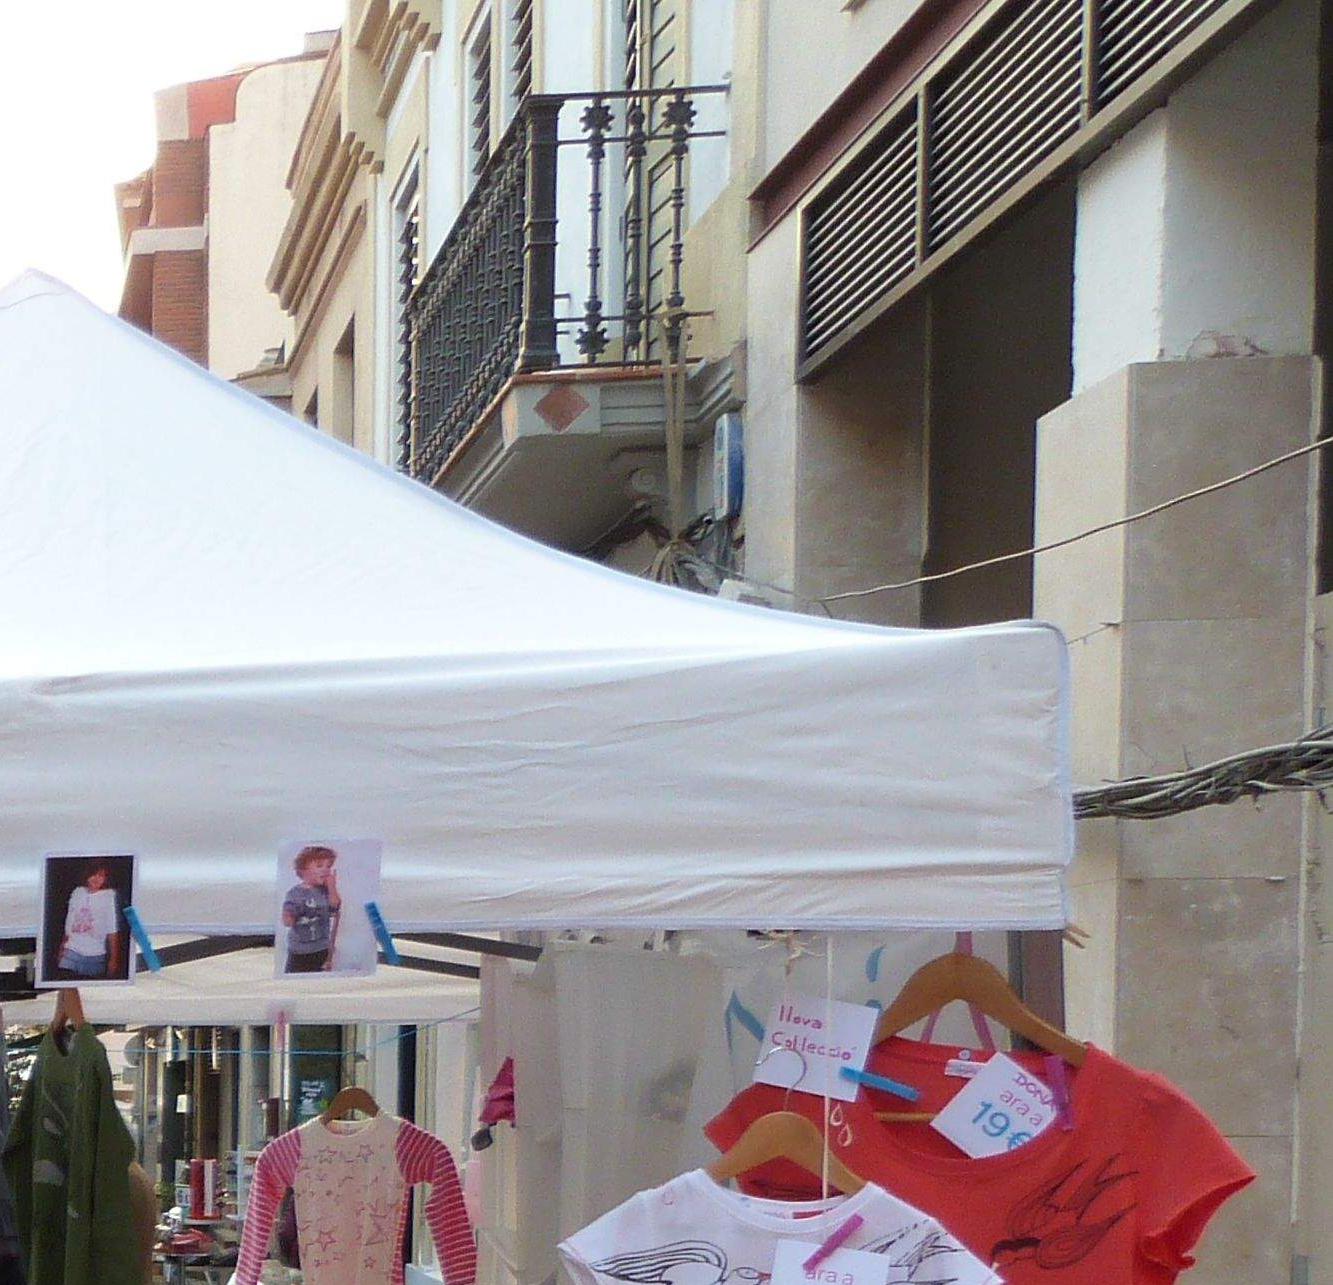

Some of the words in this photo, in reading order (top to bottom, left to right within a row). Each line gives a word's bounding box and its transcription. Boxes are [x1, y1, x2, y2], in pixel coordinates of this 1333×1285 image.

[1000, 1090, 1030, 1116] ara
[1030, 1114, 1043, 1126] a
[806, 1269, 837, 1284] ara
